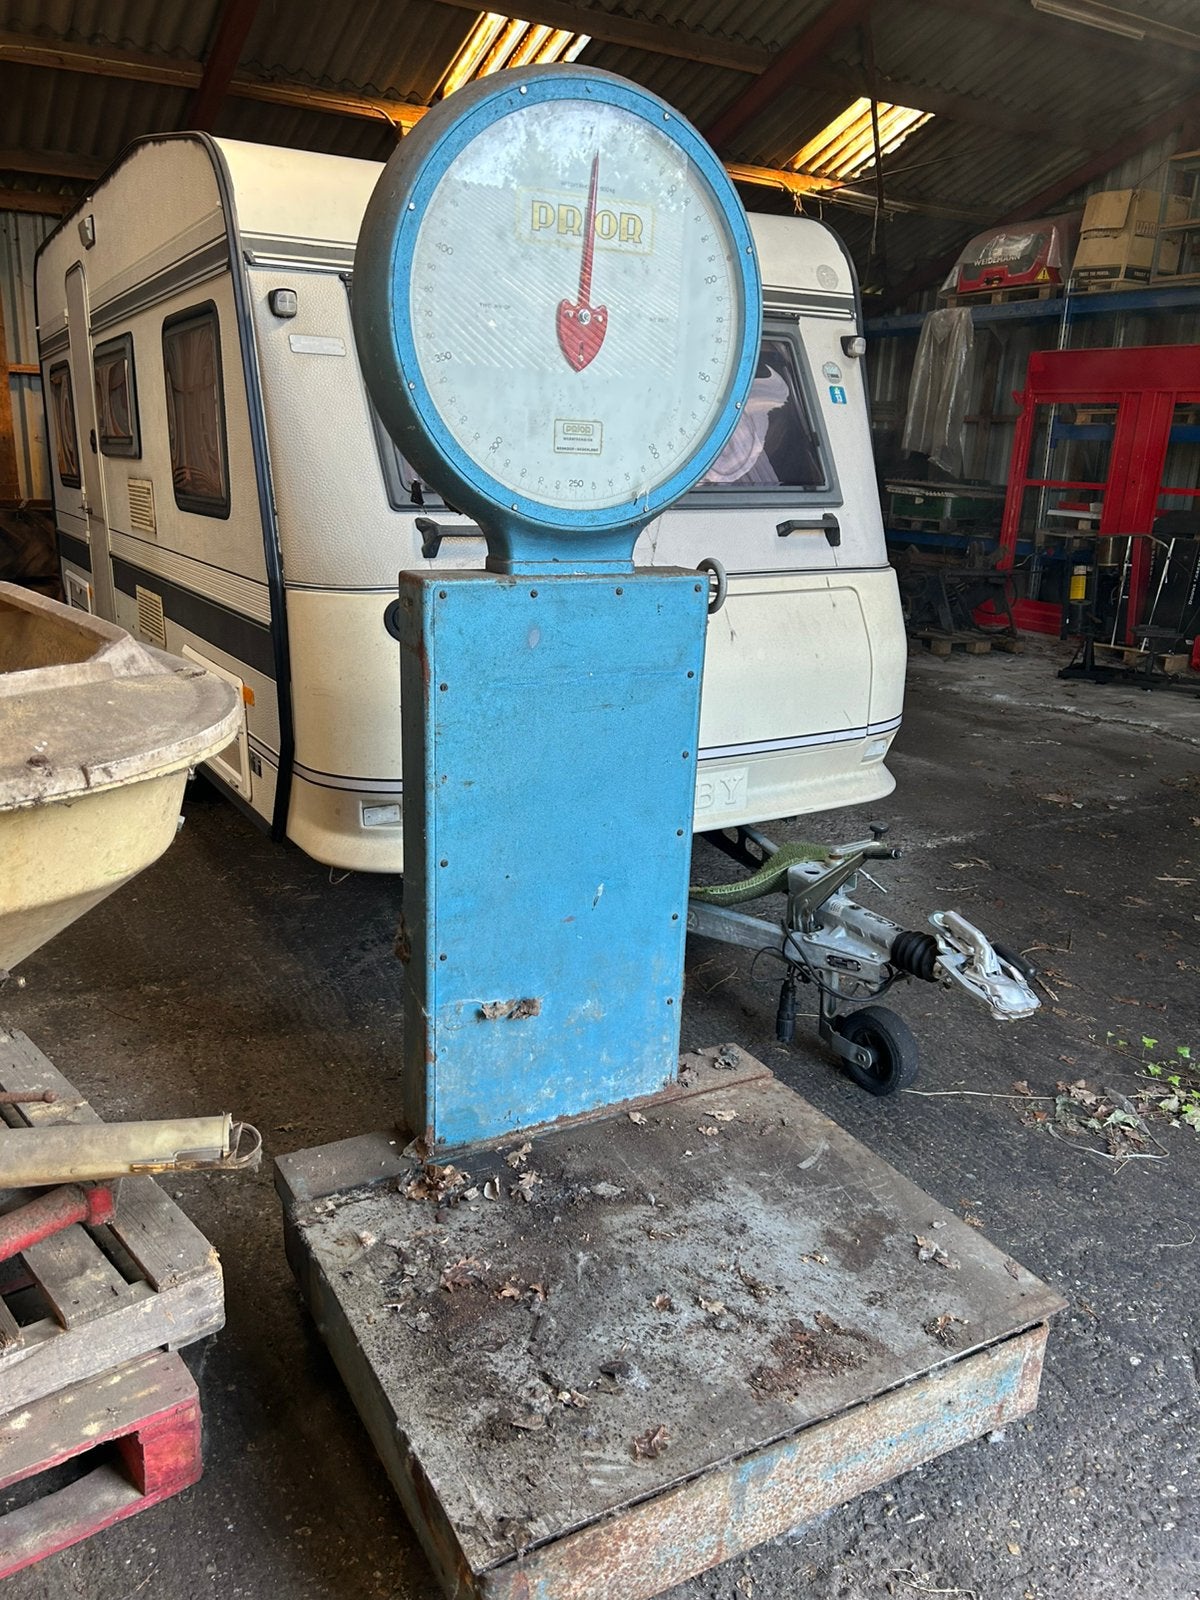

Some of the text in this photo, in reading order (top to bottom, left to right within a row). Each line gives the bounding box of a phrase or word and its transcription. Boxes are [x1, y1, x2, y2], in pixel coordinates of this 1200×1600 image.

[531, 199, 644, 244] PROR
[435, 242, 454, 256] 400
[974, 255, 1021, 267] WEIDEMANN
[704, 275, 718, 285] 100
[434, 351, 453, 363] 350
[698, 371, 711, 383] 150
[489, 436, 504, 454] 300
[648, 443, 660, 460] 200
[568, 479, 584, 488] 250
